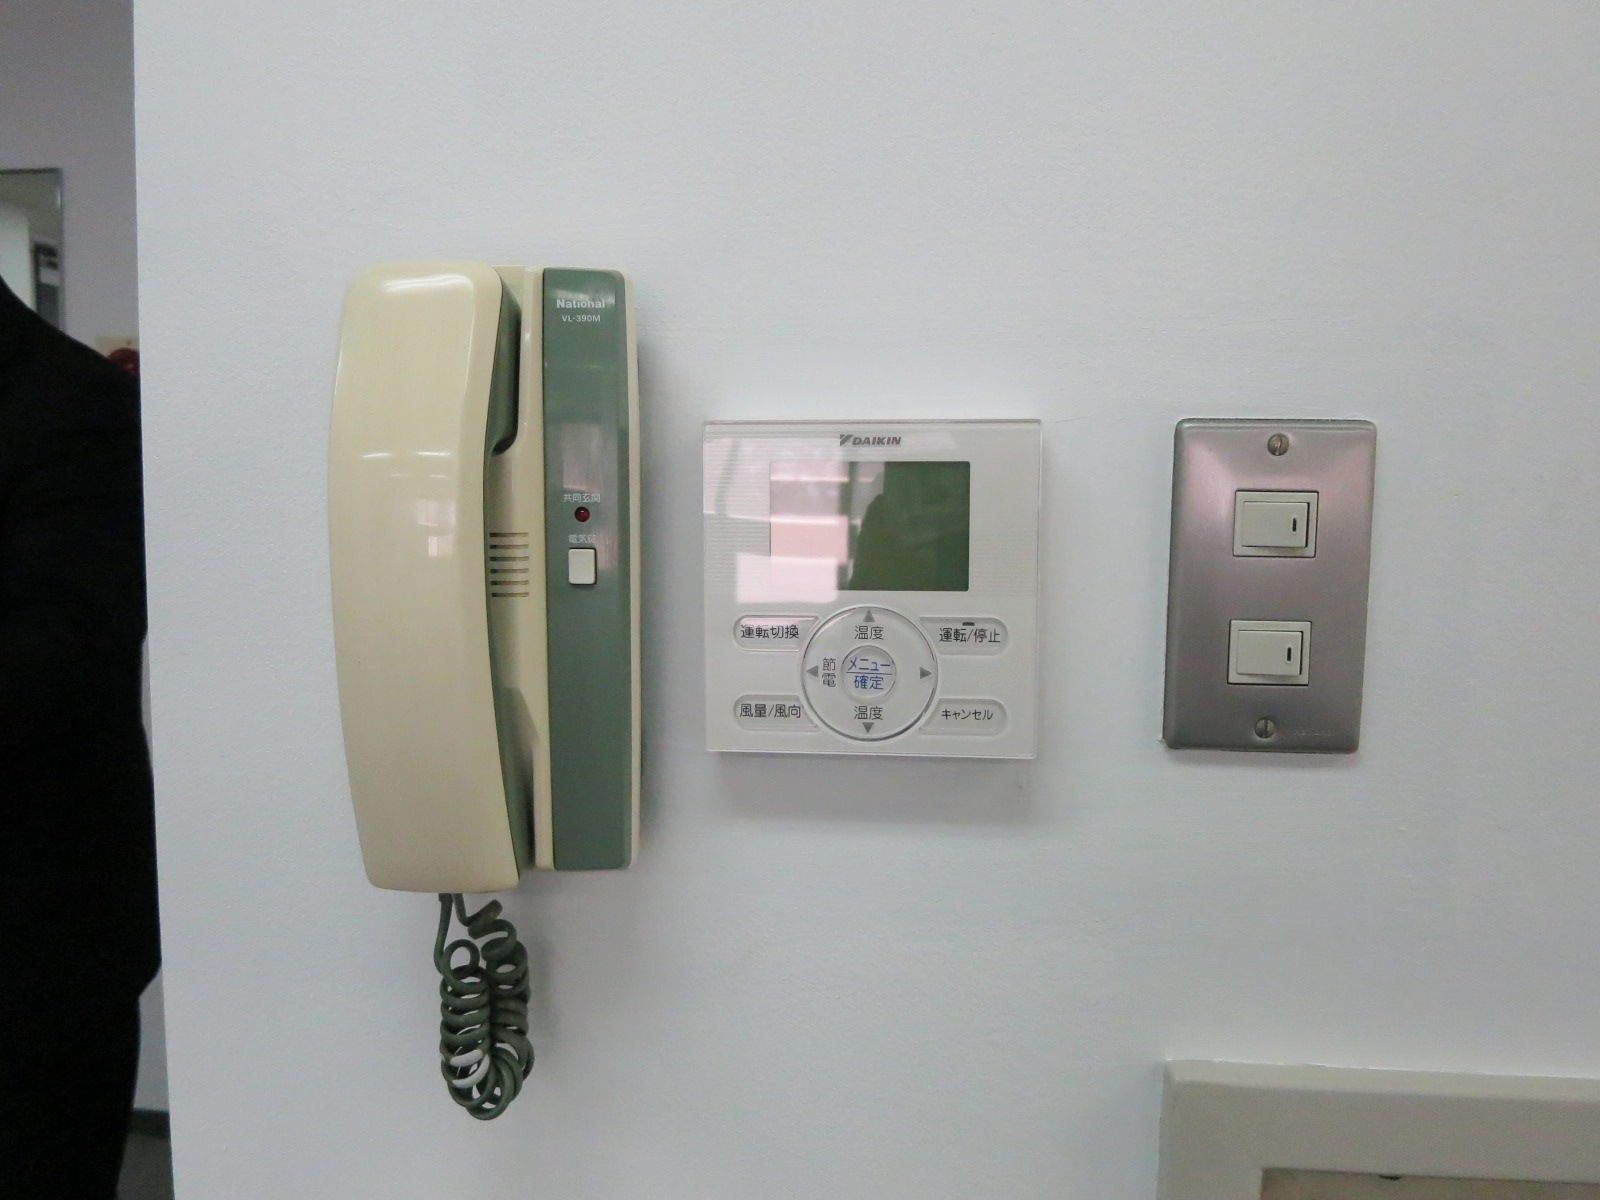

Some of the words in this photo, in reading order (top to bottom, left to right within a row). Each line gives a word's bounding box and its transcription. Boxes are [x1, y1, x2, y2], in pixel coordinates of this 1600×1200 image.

[556, 299, 606, 309] National
[852, 436, 902, 446] DAIKIN
[740, 624, 800, 639] 運転切換
[854, 625, 885, 641] 温度
[939, 628, 1001, 643] 運転/停止
[849, 657, 891, 672] メニュー
[853, 675, 884, 690] 確定
[740, 703, 802, 719] 風量/風向
[854, 705, 884, 721] 温度
[941, 709, 994, 721] キャンセル
